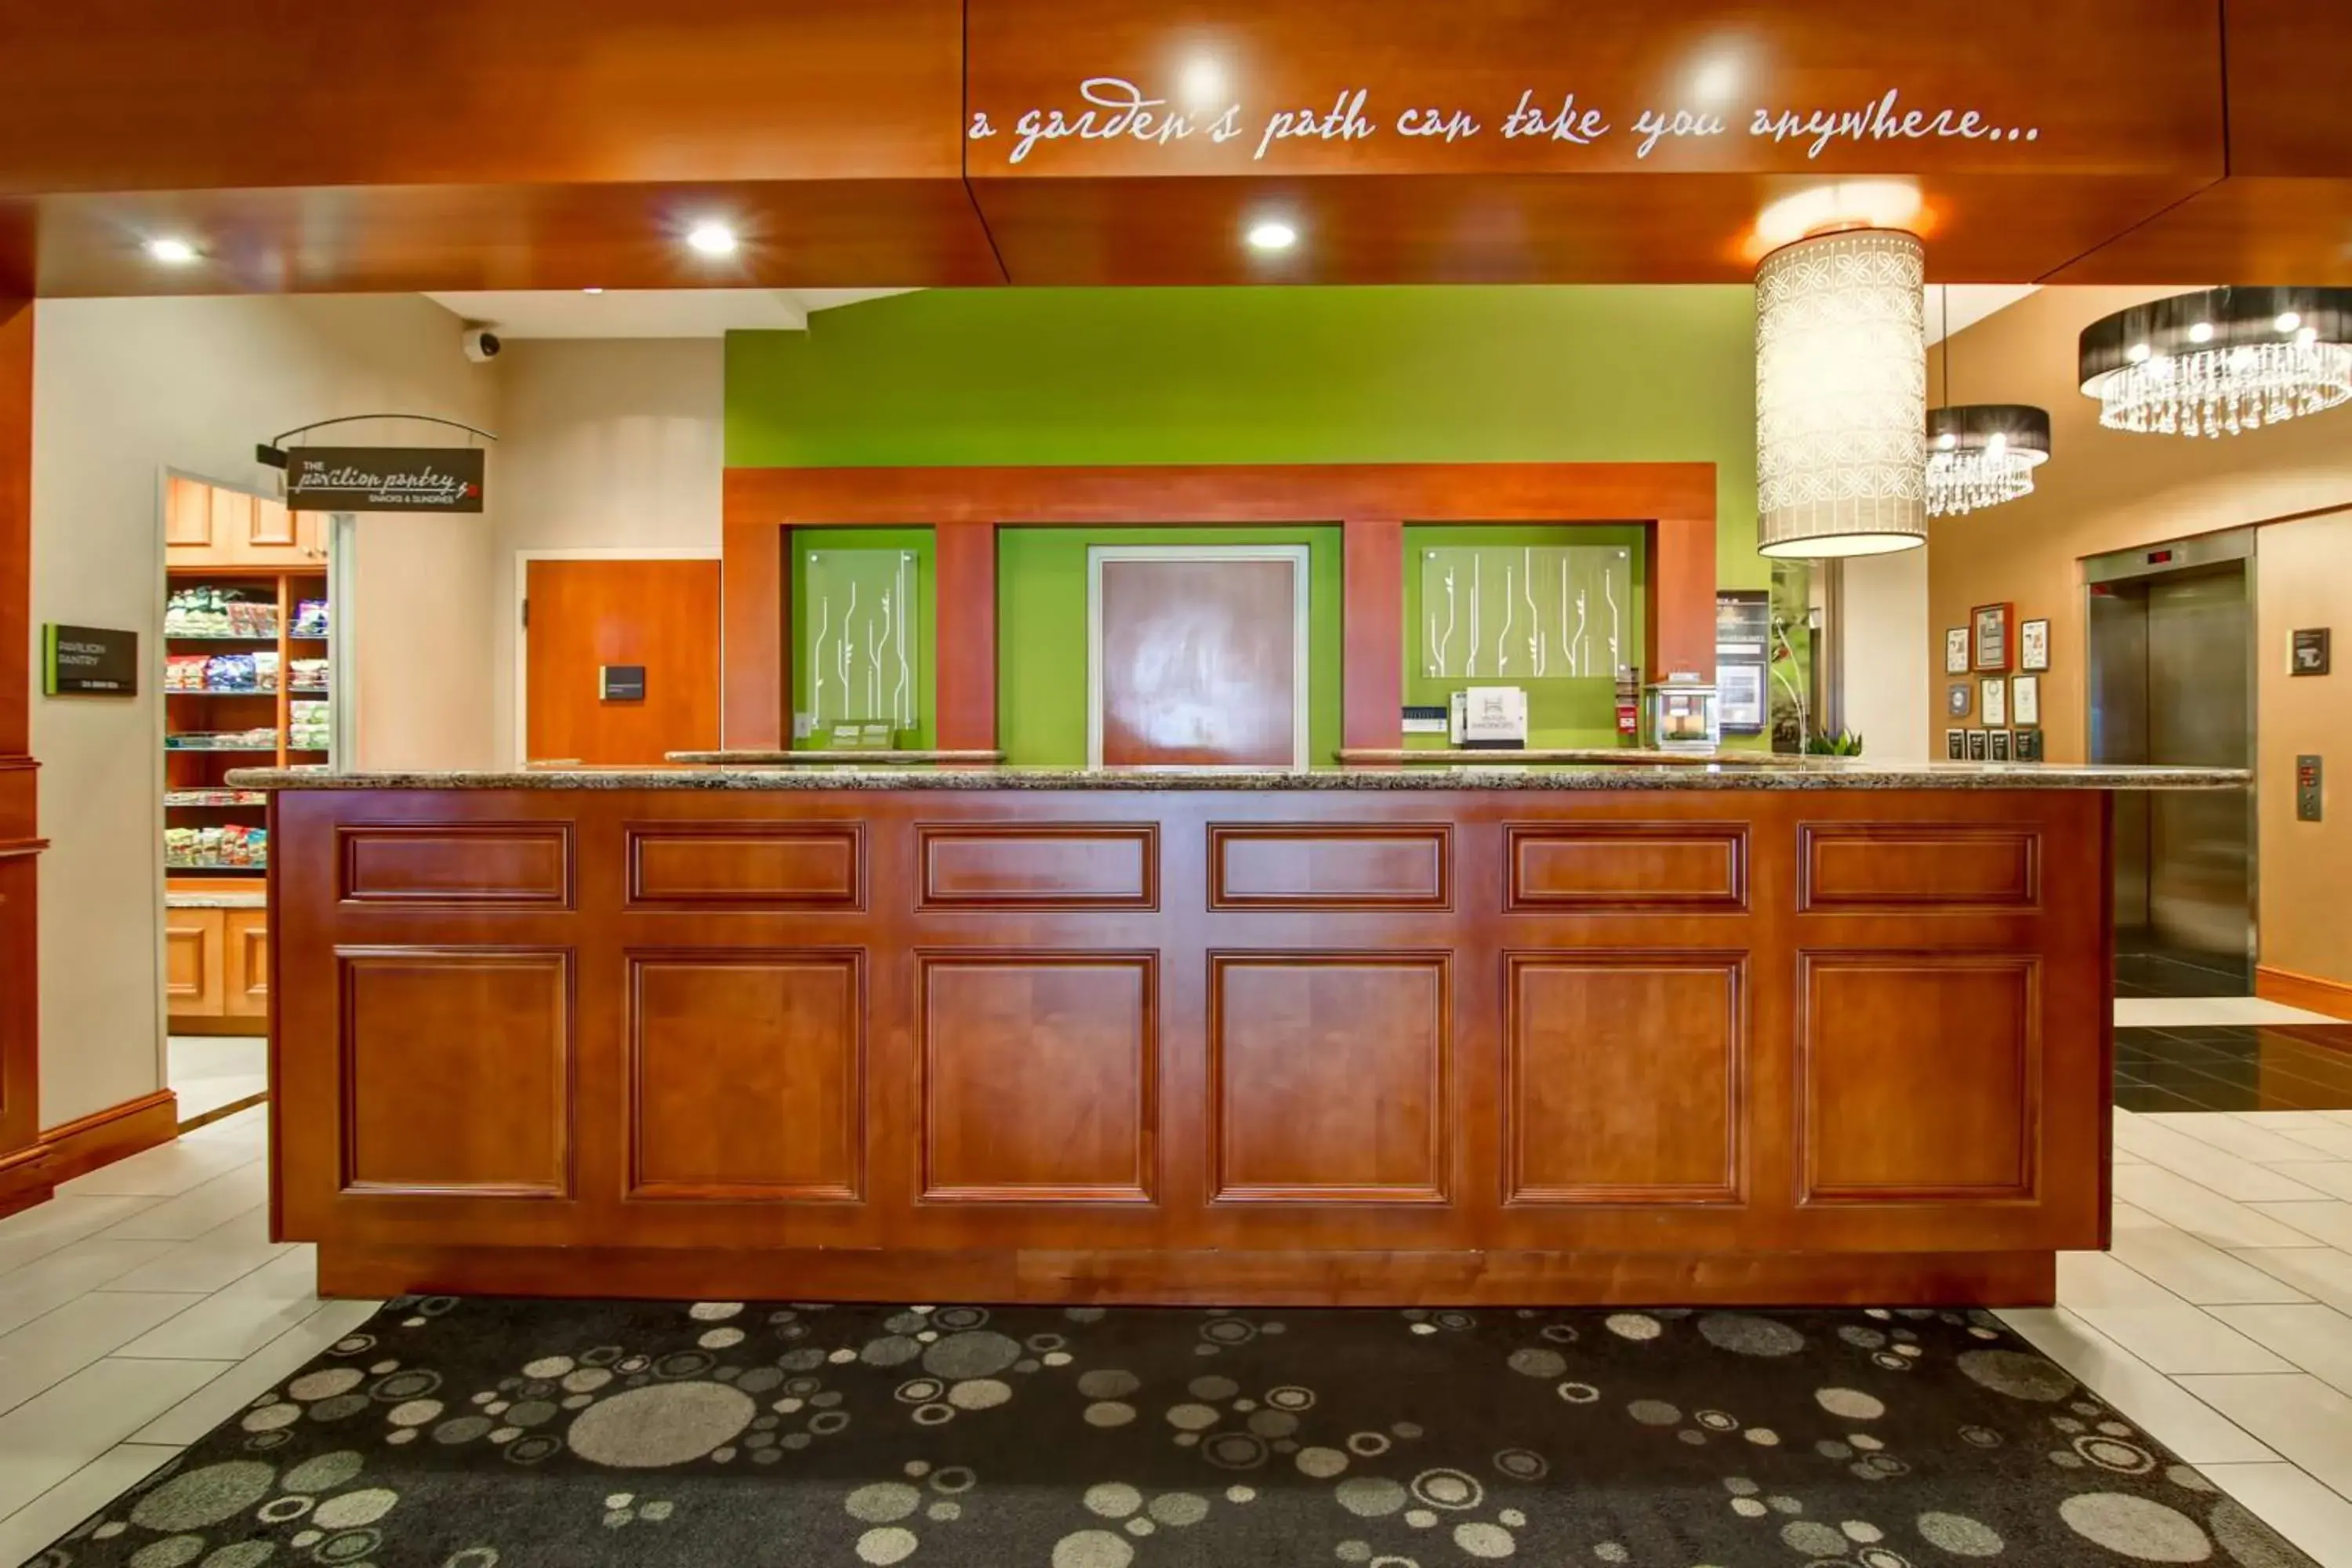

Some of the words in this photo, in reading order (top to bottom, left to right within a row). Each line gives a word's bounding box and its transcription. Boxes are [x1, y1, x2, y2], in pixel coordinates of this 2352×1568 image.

[968, 111, 997, 140] a
[1008, 77, 1243, 165] garden's
[1253, 88, 1377, 161] path
[1396, 107, 1481, 143] can
[1499, 88, 1612, 145] take
[1630, 110, 1726, 159] you
[1749, 88, 2038, 159] anywhere...
[303, 461, 325, 470] THE
[295, 466, 383, 494] pavilion
[379, 466, 456, 495] pantry
